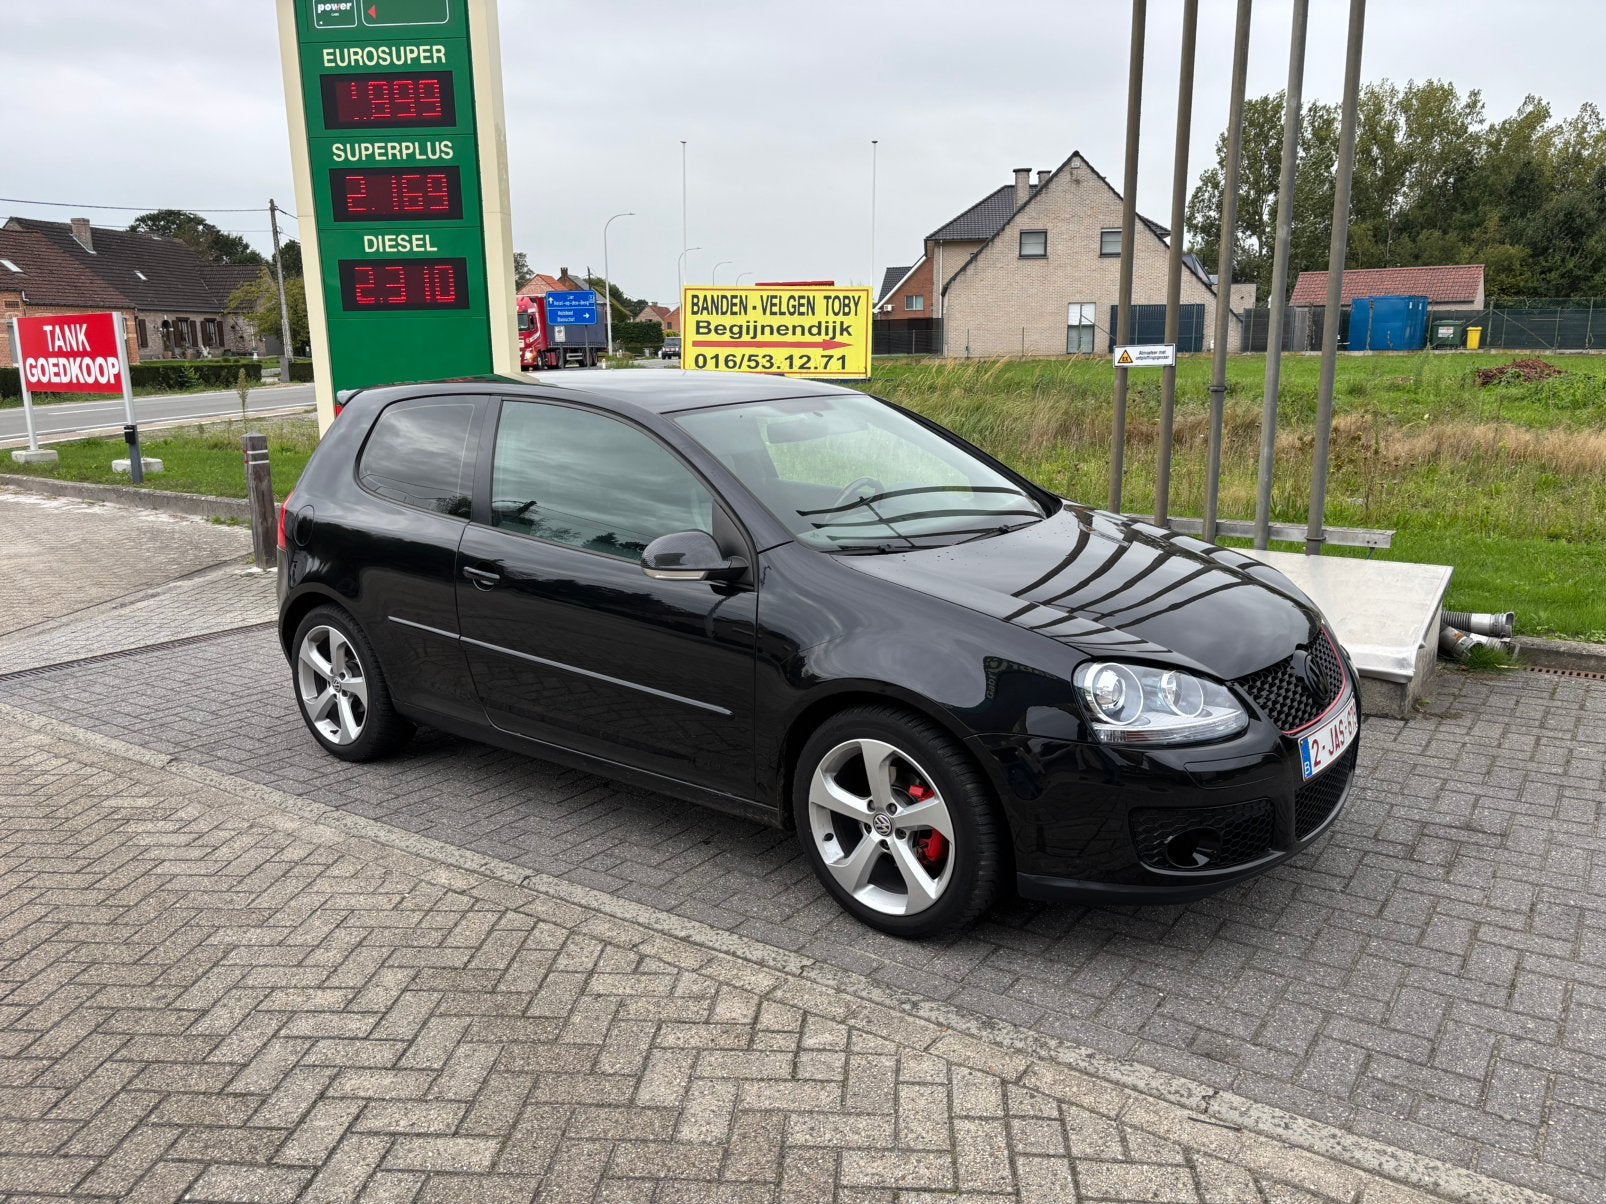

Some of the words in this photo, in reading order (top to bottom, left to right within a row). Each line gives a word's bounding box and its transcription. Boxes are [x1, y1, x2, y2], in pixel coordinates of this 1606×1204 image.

[317, 2, 352, 14] power
[323, 45, 446, 67] EUROSUPER
[332, 141, 454, 162] SUPERPLUS
[345, 174, 449, 212] 2.169
[363, 234, 438, 253] DIESEL
[354, 265, 456, 303] 2.310
[691, 294, 748, 316] BANDEN
[760, 294, 816, 317] VELGEN
[823, 295, 861, 317] TOBY
[42, 323, 91, 352] TANK
[695, 320, 853, 340] Begijnendijk
[25, 356, 120, 384] GOEDKOOP
[694, 353, 847, 370] 016/53.12.71
